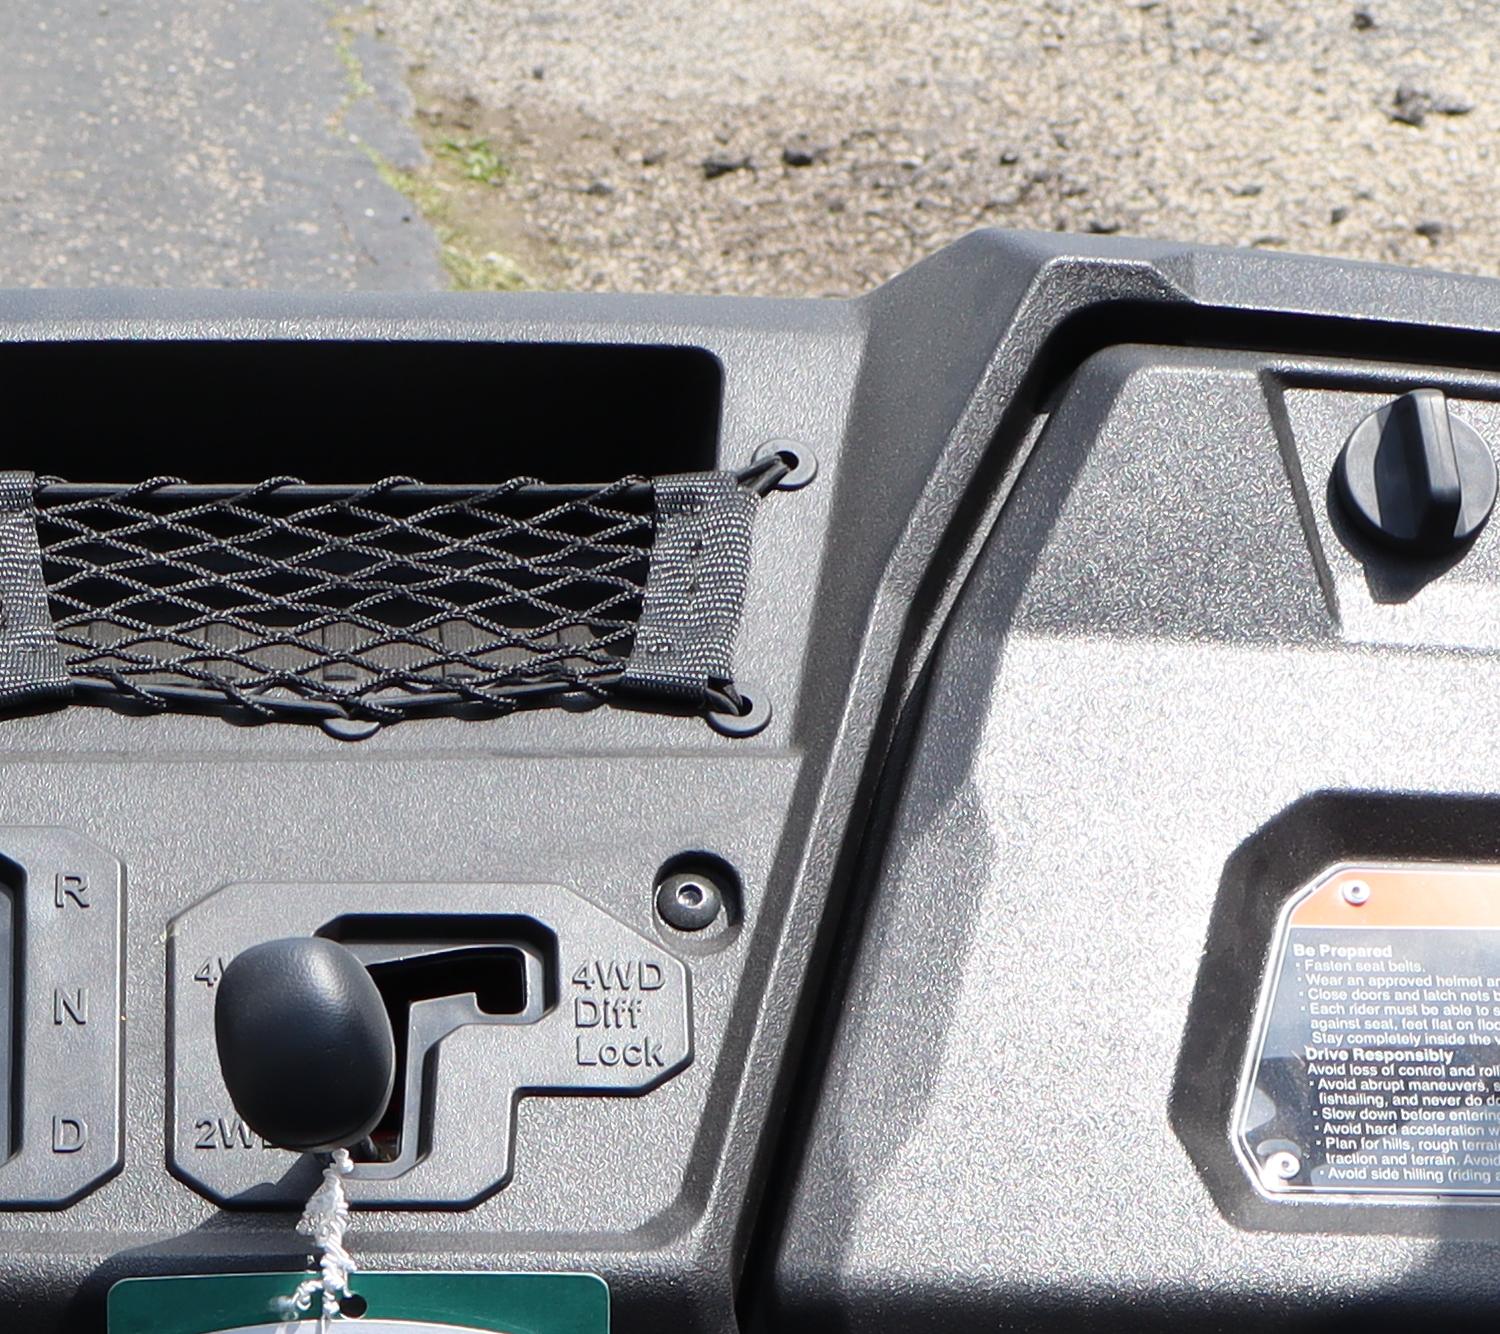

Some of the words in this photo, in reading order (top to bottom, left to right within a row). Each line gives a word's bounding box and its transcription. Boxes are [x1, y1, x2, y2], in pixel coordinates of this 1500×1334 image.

[54, 871, 90, 909] R
[1292, 943, 1316, 957] Be
[1318, 943, 1393, 961] Prepared
[1304, 960, 1352, 972] Fasten
[1355, 960, 1386, 973] seat
[571, 959, 666, 991] 4WD
[52, 987, 90, 1026] N
[574, 996, 643, 1029] Diff
[576, 1034, 665, 1067] Lock
[1305, 1047, 1349, 1061] Drive
[1352, 1048, 1454, 1066] Responsibly
[1306, 1063, 1346, 1076] Avoid
[1350, 1064, 1378, 1076] loss
[1380, 1064, 1396, 1076] of
[1398, 1065, 1446, 1077] control
[1449, 1065, 1476, 1077] and
[52, 1115, 88, 1153] D
[194, 1117, 277, 1150] 2W
